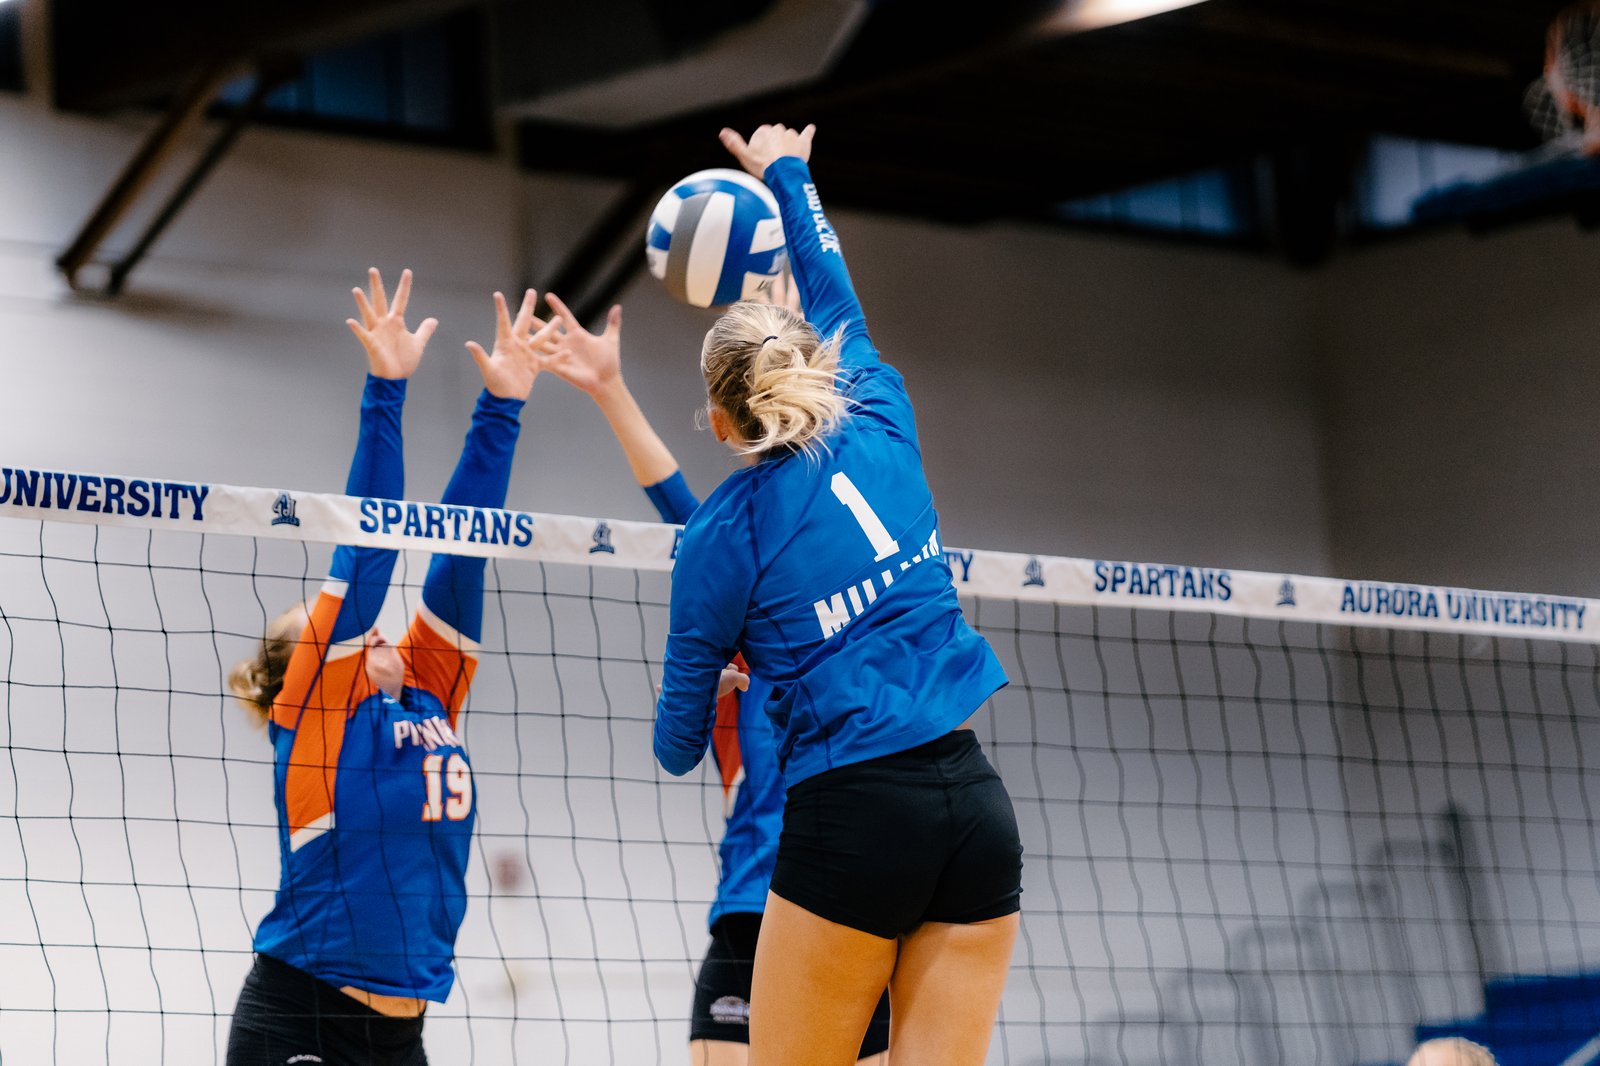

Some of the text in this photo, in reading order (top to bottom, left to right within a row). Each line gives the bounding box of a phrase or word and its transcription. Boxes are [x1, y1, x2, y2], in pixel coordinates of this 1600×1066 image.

[360, 498, 533, 547] SPARTANS
[831, 471, 900, 562] 1
[1094, 560, 1232, 601] SPARTANS
[1341, 585, 1587, 630] AURORA UNIVERSITY
[422, 753, 472, 822] 19
